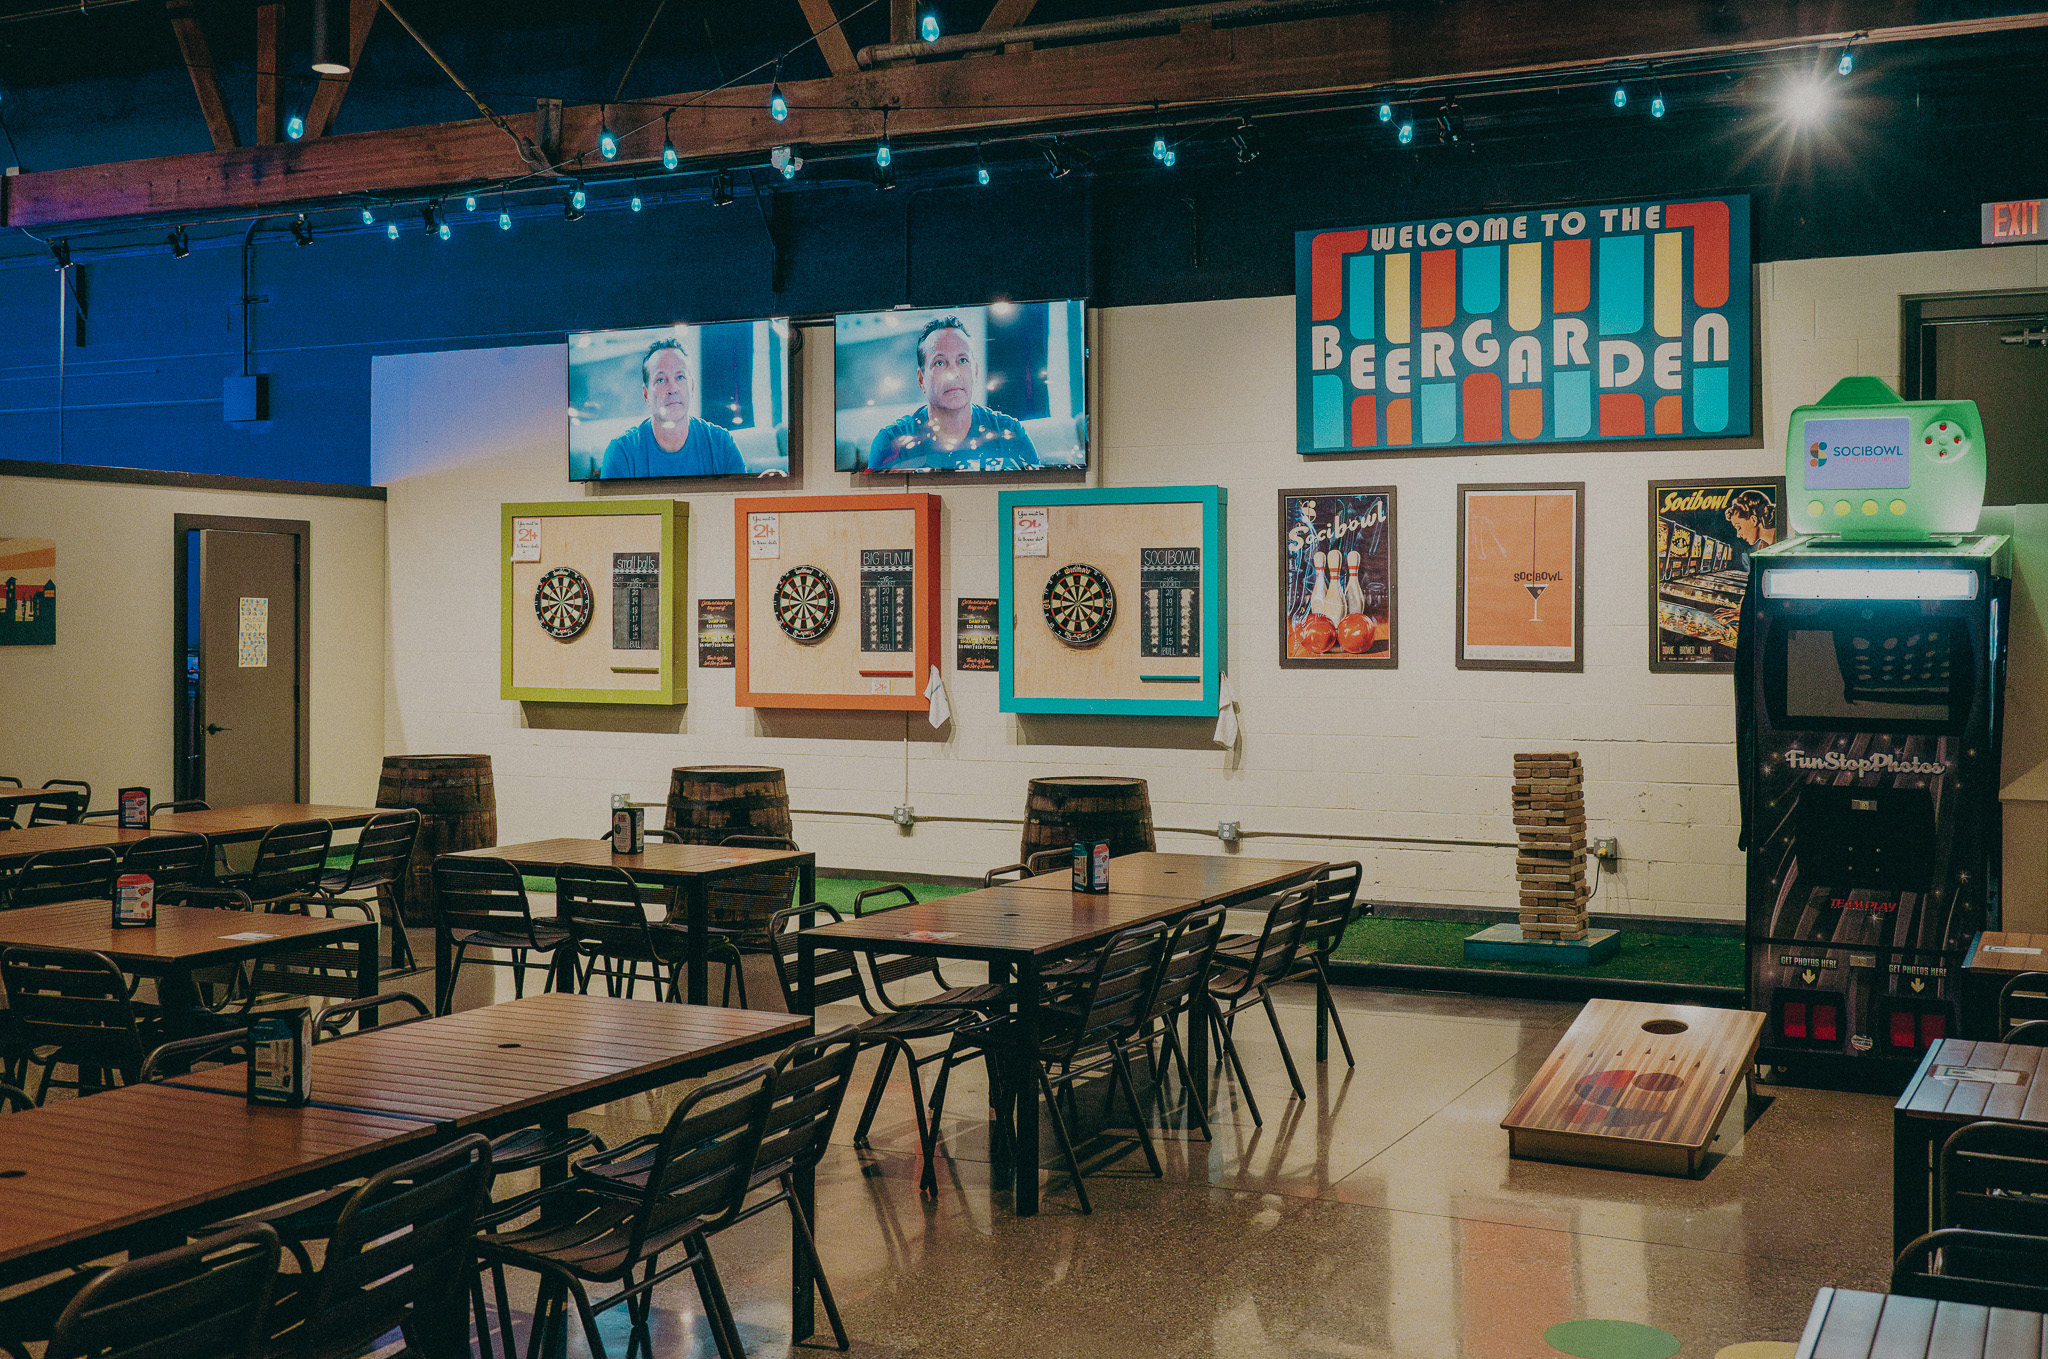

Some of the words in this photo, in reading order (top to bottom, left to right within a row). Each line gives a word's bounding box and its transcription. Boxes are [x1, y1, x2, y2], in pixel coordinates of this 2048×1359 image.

[1993, 200, 2041, 238] EXIT
[1371, 215, 1528, 252] WELCOME
[1541, 210, 1587, 237] TO
[1600, 204, 1661, 233] THE
[1832, 445, 1904, 457] SOCIBOWL
[1851, 456, 1879, 464] PIGEON
[1660, 488, 1734, 514] Socibowl
[753, 523, 776, 538] 21+
[1288, 499, 1387, 553] Socibowl
[518, 528, 538, 542] 21+
[616, 555, 636, 570] small
[863, 551, 880, 566] BIG
[1143, 549, 1199, 567] SOCIBOWL
[1784, 749, 1946, 778] FunStopPhotos
[1830, 898, 1864, 910] TEAM
[1864, 900, 1897, 913] PLAY
[1780, 955, 1792, 966] GET
[1793, 956, 1820, 967] PHOTOS
[1820, 958, 1838, 969] HERE
[1888, 963, 1901, 974] GET
[1902, 965, 1929, 975] PHOTOS
[1930, 966, 1948, 977] HERE
